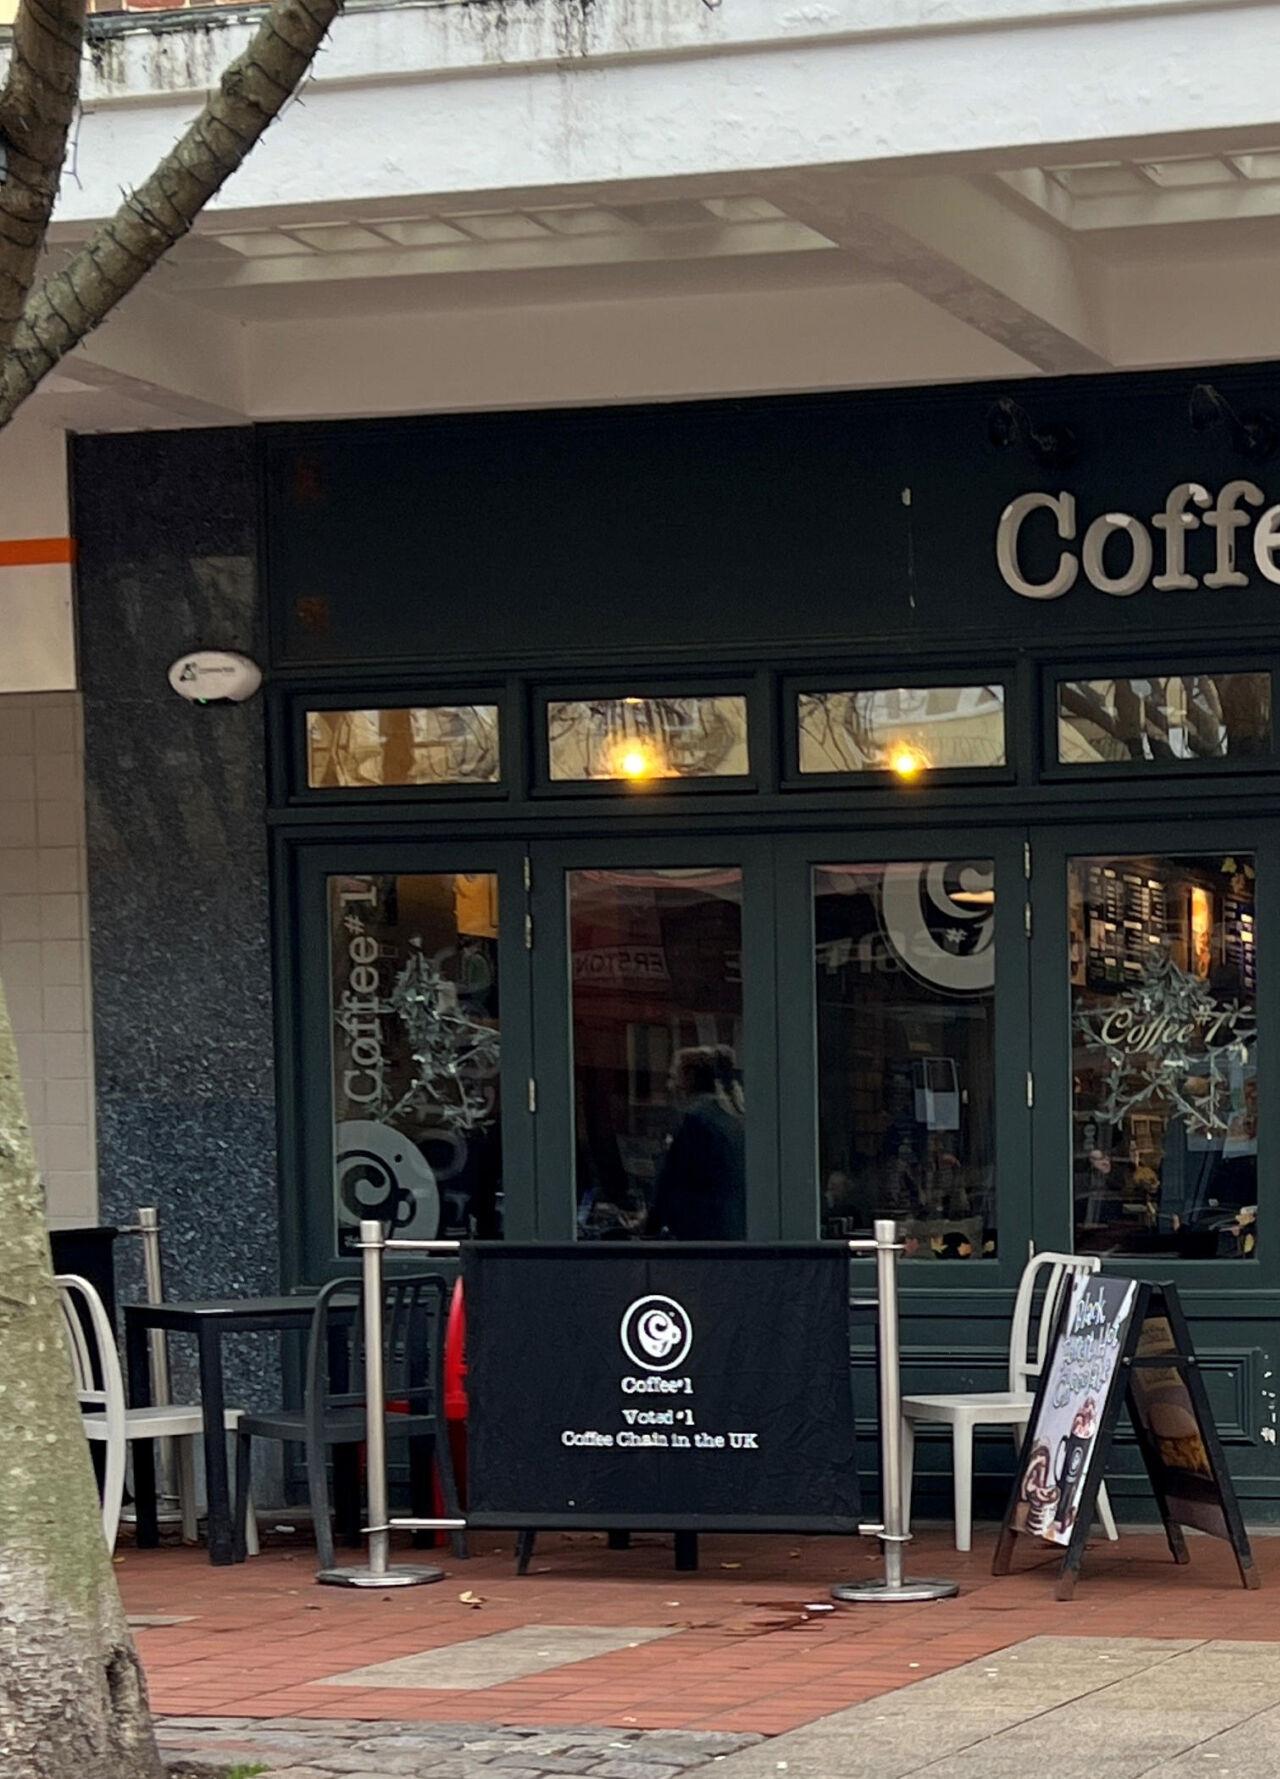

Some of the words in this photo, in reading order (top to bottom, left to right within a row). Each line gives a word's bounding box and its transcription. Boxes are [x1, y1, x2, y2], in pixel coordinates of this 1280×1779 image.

[622, 1409, 674, 1425] Voted
[561, 1431, 613, 1446] Coffee
[616, 1432, 668, 1447] Chain
[671, 1432, 691, 1447] in
[694, 1432, 725, 1448] the
[728, 1433, 759, 1448] UK
